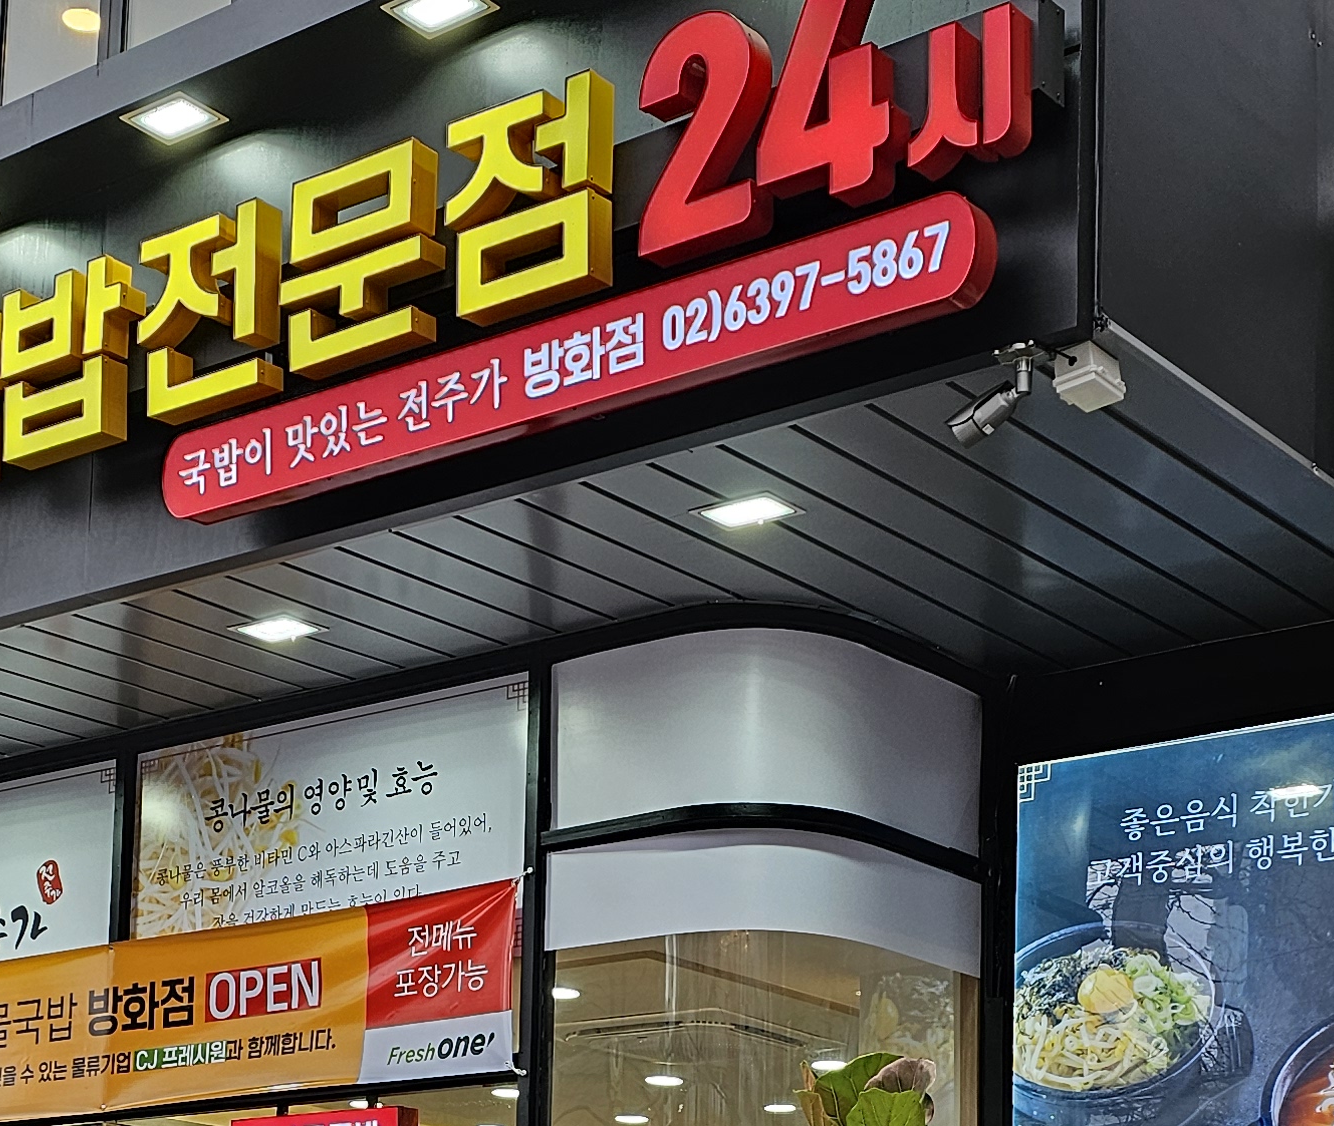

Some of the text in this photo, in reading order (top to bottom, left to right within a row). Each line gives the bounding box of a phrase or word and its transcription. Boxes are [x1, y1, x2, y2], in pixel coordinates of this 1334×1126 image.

[638, 0, 1034, 266] 24시
[177, 220, 951, 496] 국밥이 맛있는 전주가 방화점 02)6397-5867
[204, 760, 439, 833] 콩나물의 영양 및 효능
[1119, 792, 1239, 843] 좋은음식
[155, 811, 493, 887] 콩나물은 풍부한 비타민 C와 아스파라긴산이 들어있어,
[179, 849, 462, 909] 우리 몸에서 알코올을 해독하는데 도움을 주고
[1092, 842, 1237, 886] 고객중심의
[406, 919, 478, 959] 전메뉴
[87, 976, 195, 1038] 방화점
[208, 959, 320, 1021] OPEN
[392, 959, 490, 1001] 포장가능
[19, 1064, 36, 1084] 수
[37, 1059, 69, 1083] 있는
[70, 1050, 133, 1079] 물류기업
[135, 1048, 159, 1072] CJ
[161, 1037, 245, 1070] 프레시원과
[247, 1027, 338, 1058] 함께합니다.
